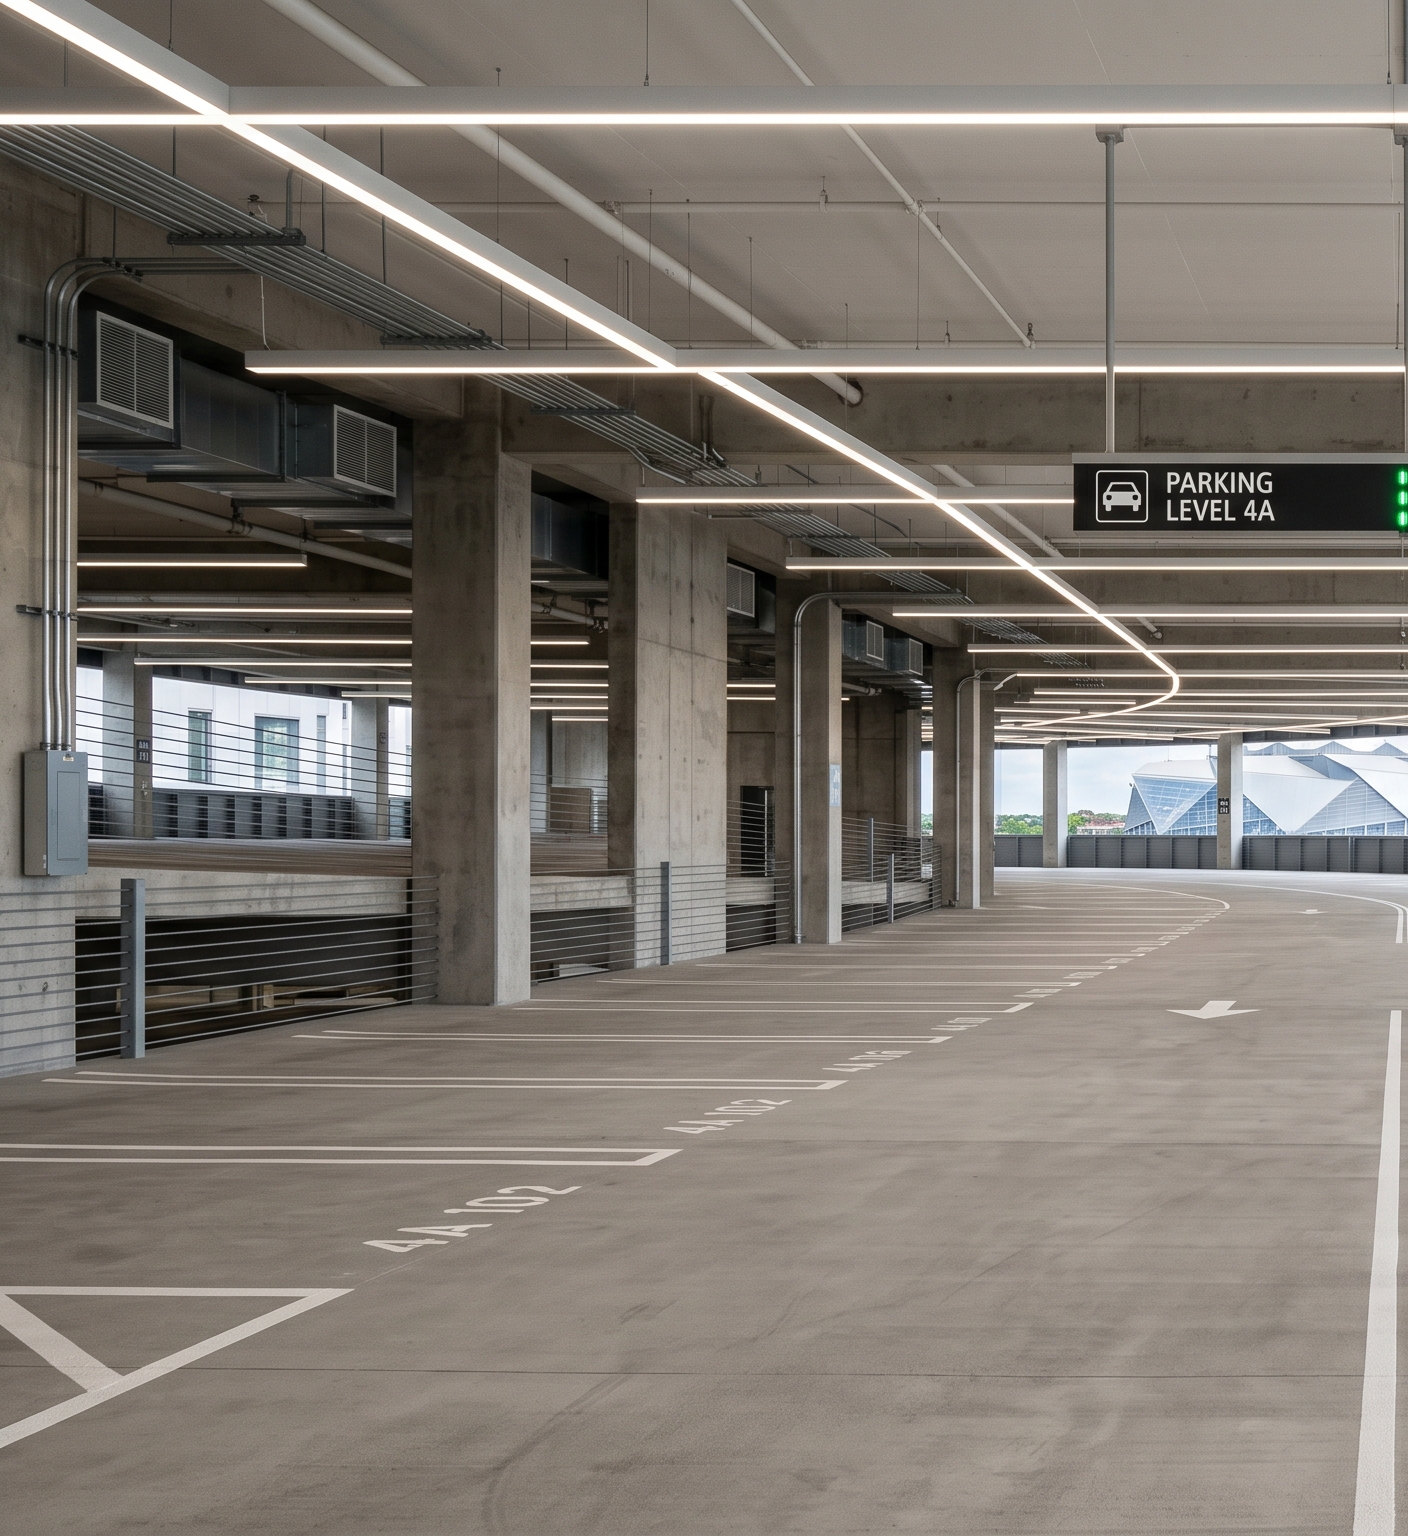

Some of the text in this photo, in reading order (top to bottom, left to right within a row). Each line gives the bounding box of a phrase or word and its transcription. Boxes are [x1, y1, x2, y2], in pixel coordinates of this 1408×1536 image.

[1166, 471, 1273, 494] PARKING
[1166, 499, 1276, 522] LEVEL 4A
[663, 1099, 793, 1134] 4A 102
[362, 1185, 583, 1252] 4A 102
